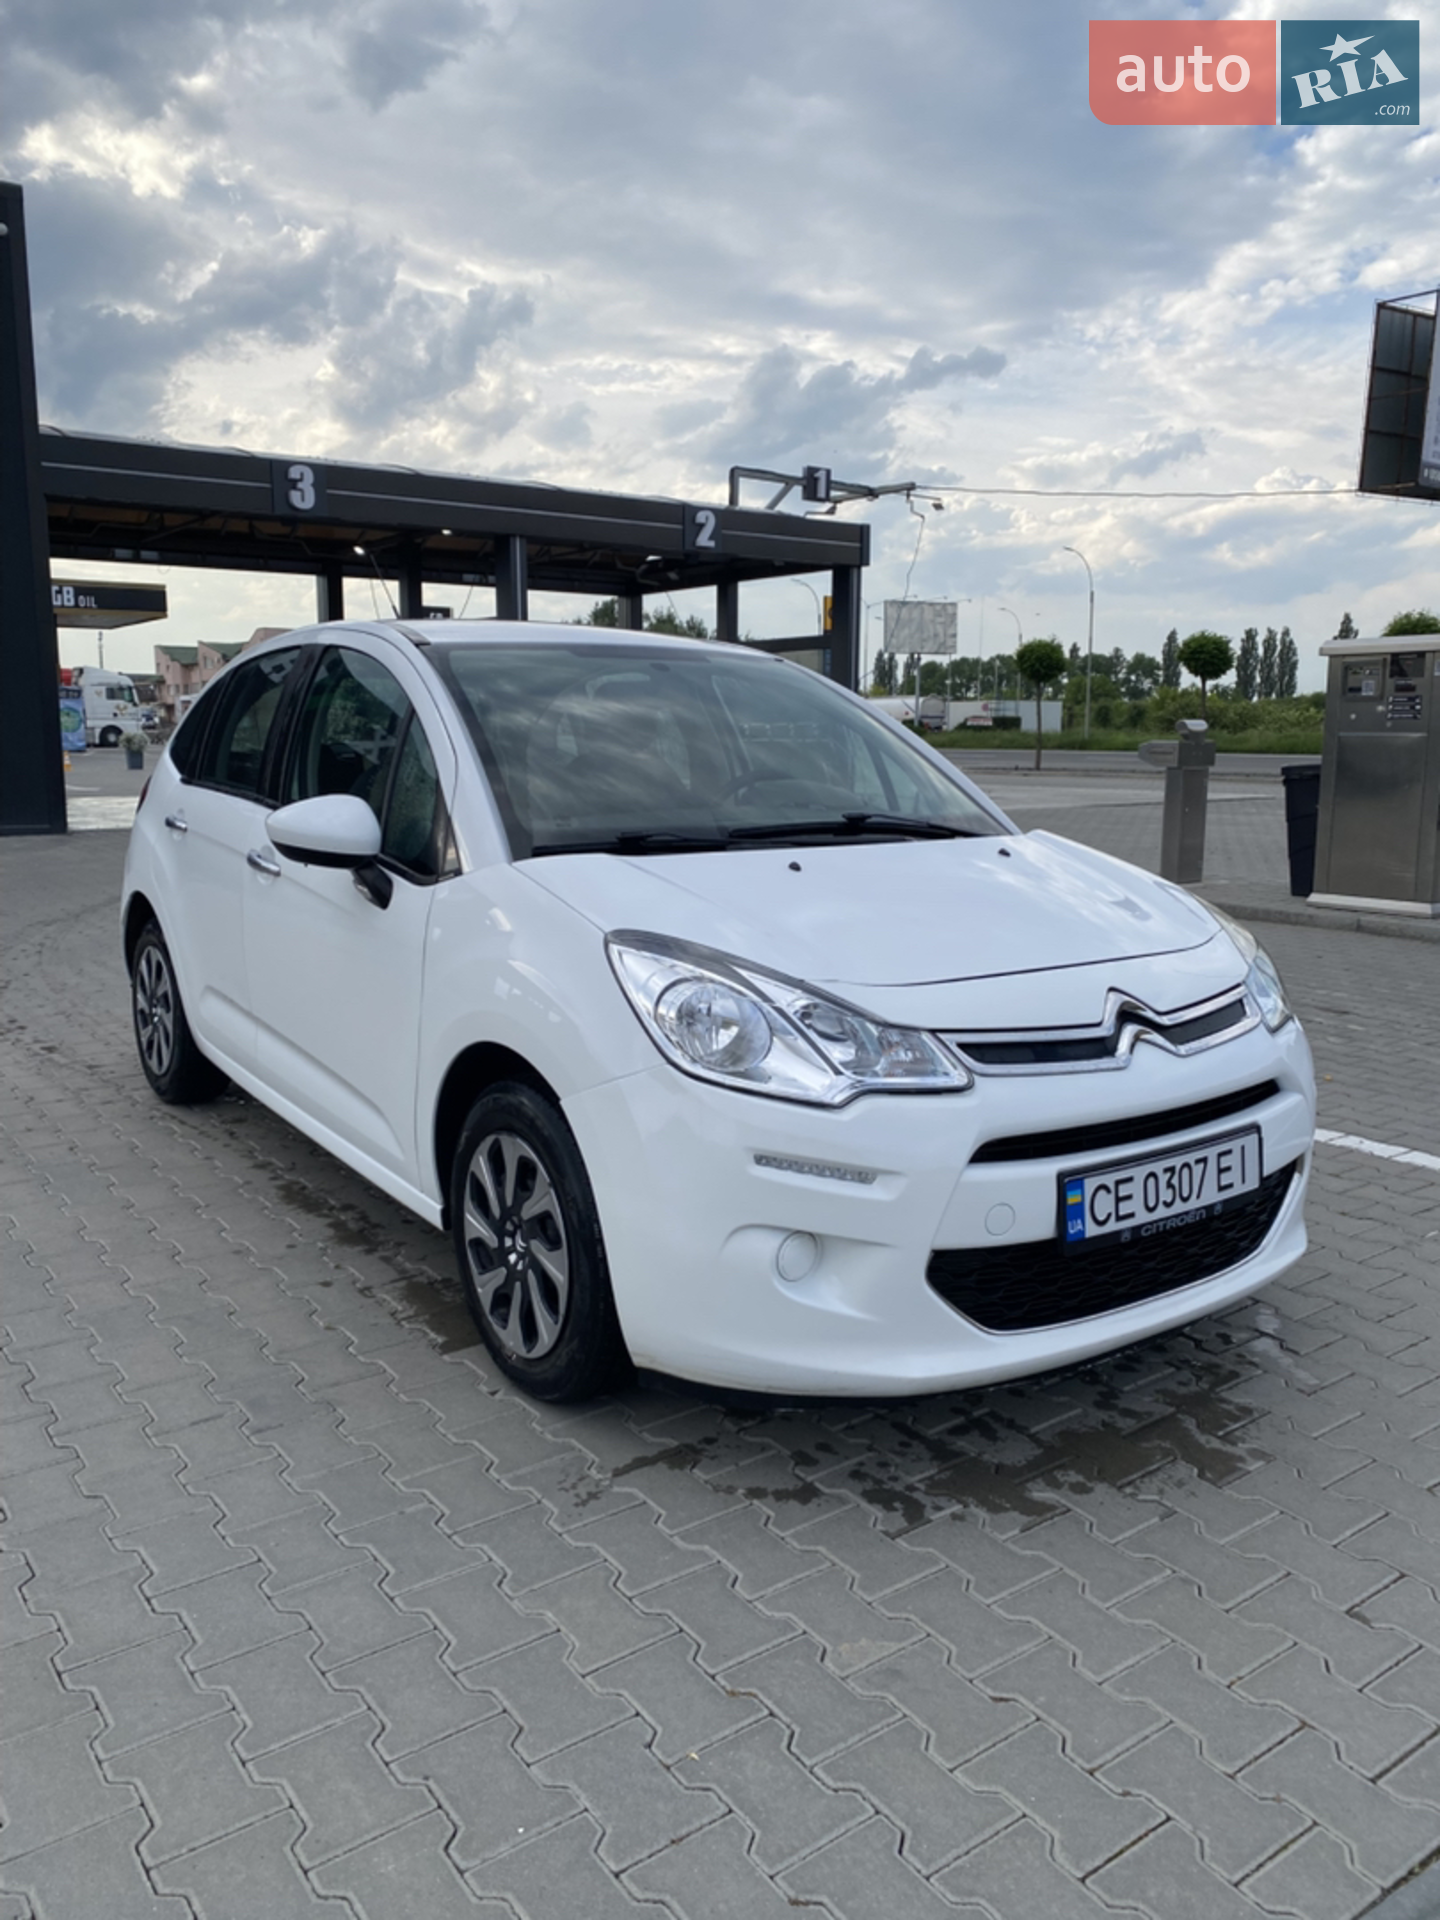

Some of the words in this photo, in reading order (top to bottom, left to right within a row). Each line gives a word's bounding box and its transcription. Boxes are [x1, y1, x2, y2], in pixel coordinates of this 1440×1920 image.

[288, 464, 315, 510] 3
[814, 470, 827, 498] 1
[695, 510, 716, 548] 2
[78, 595, 97, 608] OIL
[1090, 1177, 1136, 1227] CE
[1143, 1156, 1209, 1213] 0307
[1217, 1145, 1246, 1193] EI
[1068, 1220, 1083, 1234] UA
